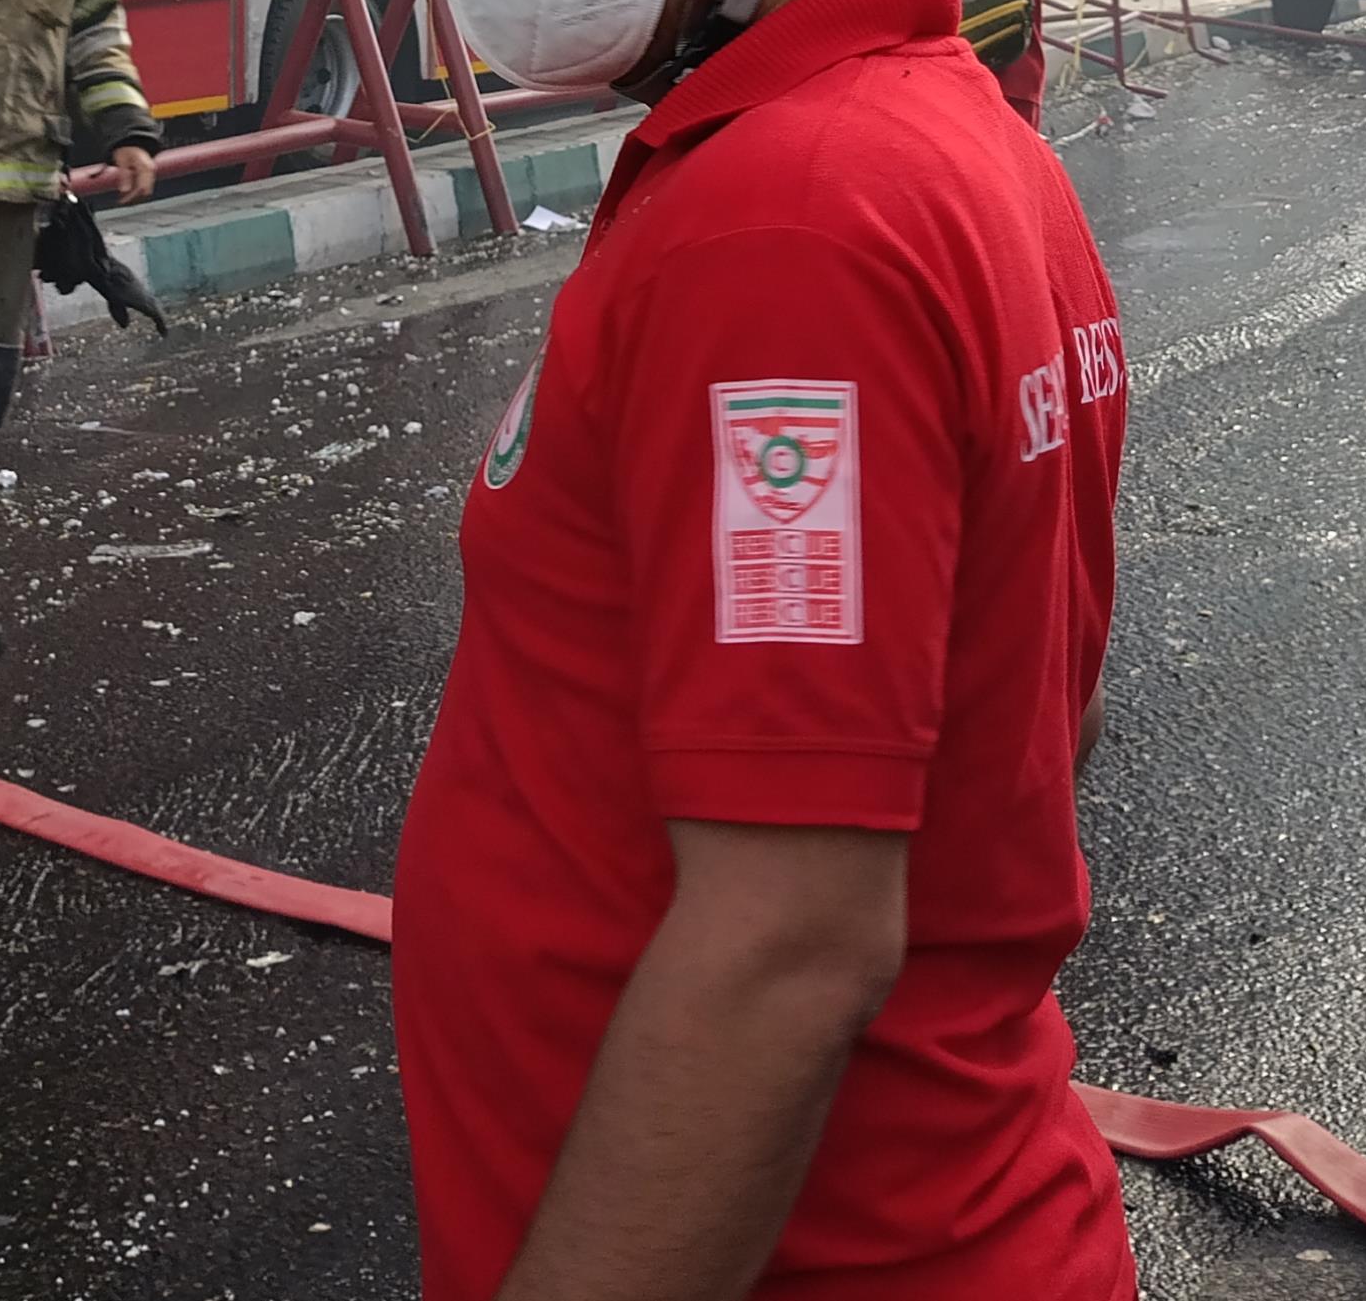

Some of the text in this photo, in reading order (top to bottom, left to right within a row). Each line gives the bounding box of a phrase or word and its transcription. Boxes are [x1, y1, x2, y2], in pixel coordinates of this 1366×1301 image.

[1073, 316, 1125, 404] RES
[732, 531, 841, 557] RESCUE
[734, 565, 841, 591] RESCUE
[734, 599, 842, 626] RESCUE
